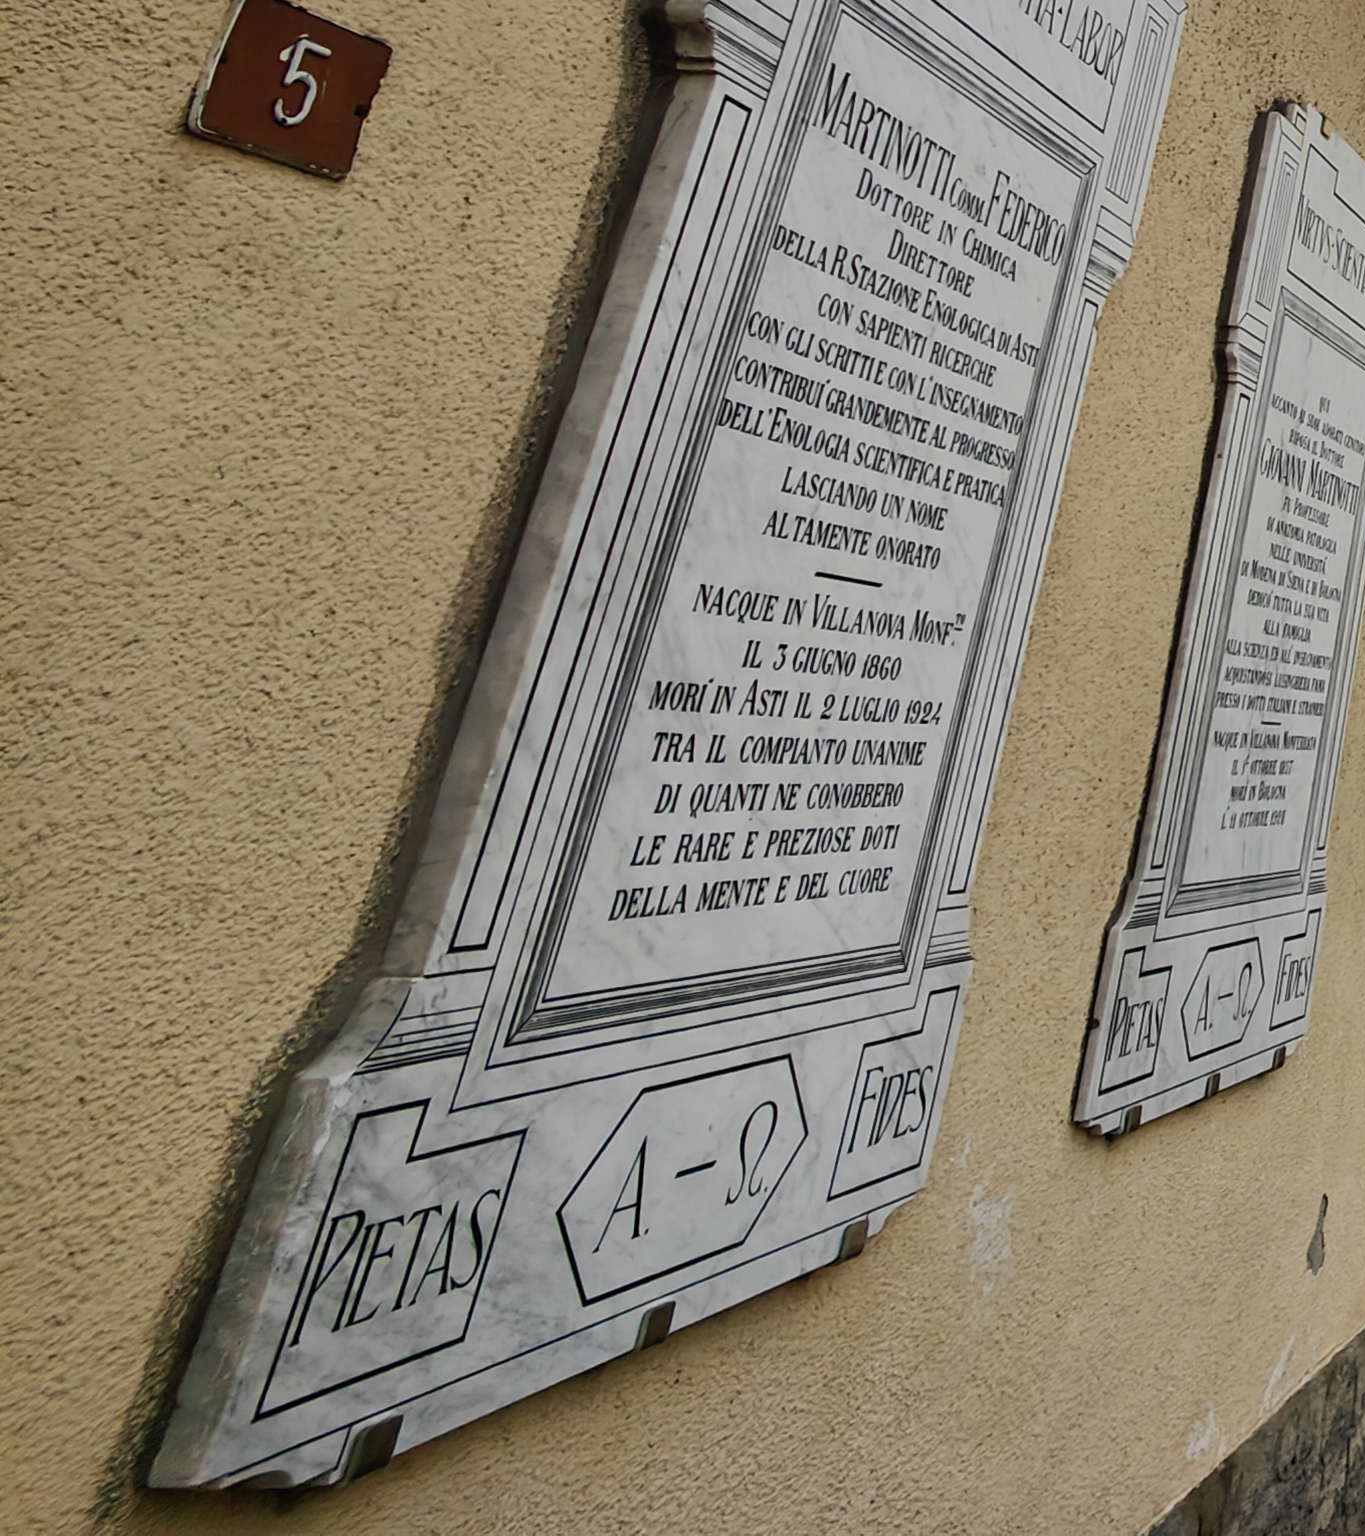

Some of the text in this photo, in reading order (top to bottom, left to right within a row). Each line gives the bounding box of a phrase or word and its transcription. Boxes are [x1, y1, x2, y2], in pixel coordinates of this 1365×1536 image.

[273, 34, 332, 126] 5
[812, 62, 957, 202] MARTINOTTI
[983, 169, 1067, 266] FEDERICO
[855, 167, 1017, 282] DOTTORE IN CHIMICA
[772, 224, 828, 273] DELLA
[921, 288, 996, 349] ENOLOGICA
[996, 331, 1013, 356] DI
[1009, 332, 1040, 368] ASTI
[886, 228, 975, 298] DIRETTORE
[747, 311, 785, 345] CON
[785, 326, 816, 359] GLI
[814, 338, 876, 382] SCRITTI
[873, 360, 888, 386] E
[887, 366, 916, 396] CON
[817, 293, 997, 388] CON SAPIENTI RICERCHE
[825, 387, 931, 444] GRANDEMENTE
[928, 423, 948, 450] AL
[949, 430, 1016, 471] PROGRESSO
[780, 466, 949, 532] LASCIANDO UN NOME
[852, 441, 941, 489] SCIENTIFICA
[942, 468, 956, 493] E
[953, 472, 1006, 509] PRATICA
[761, 510, 941, 570] ALTAMENTE ONORATO
[692, 583, 780, 624] NACQUE
[782, 597, 808, 625] IN
[812, 593, 905, 641] VILLANOVA
[741, 639, 902, 681] IL 3 GIUGNO 1860
[709, 685, 737, 714] IN
[737, 678, 789, 718] ASTI
[793, 691, 812, 720] IL
[819, 693, 836, 720] 2
[838, 695, 900, 723] LUGLIO
[903, 699, 943, 726] 1924
[651, 731, 927, 766] TRA IL COMPIANTO UNANIME
[653, 782, 904, 819] DI QUANTI NE CONOBBERO
[629, 823, 901, 867] LE RARE E PREZIOSE DOTI
[607, 866, 894, 922] DELLA MENTE E DEL CUORE
[1277, 953, 1311, 1005] FIDES
[1107, 996, 1163, 1062] PIETAS
[847, 1066, 933, 1154] FIDES
[289, 1189, 501, 1348] PIETAS
